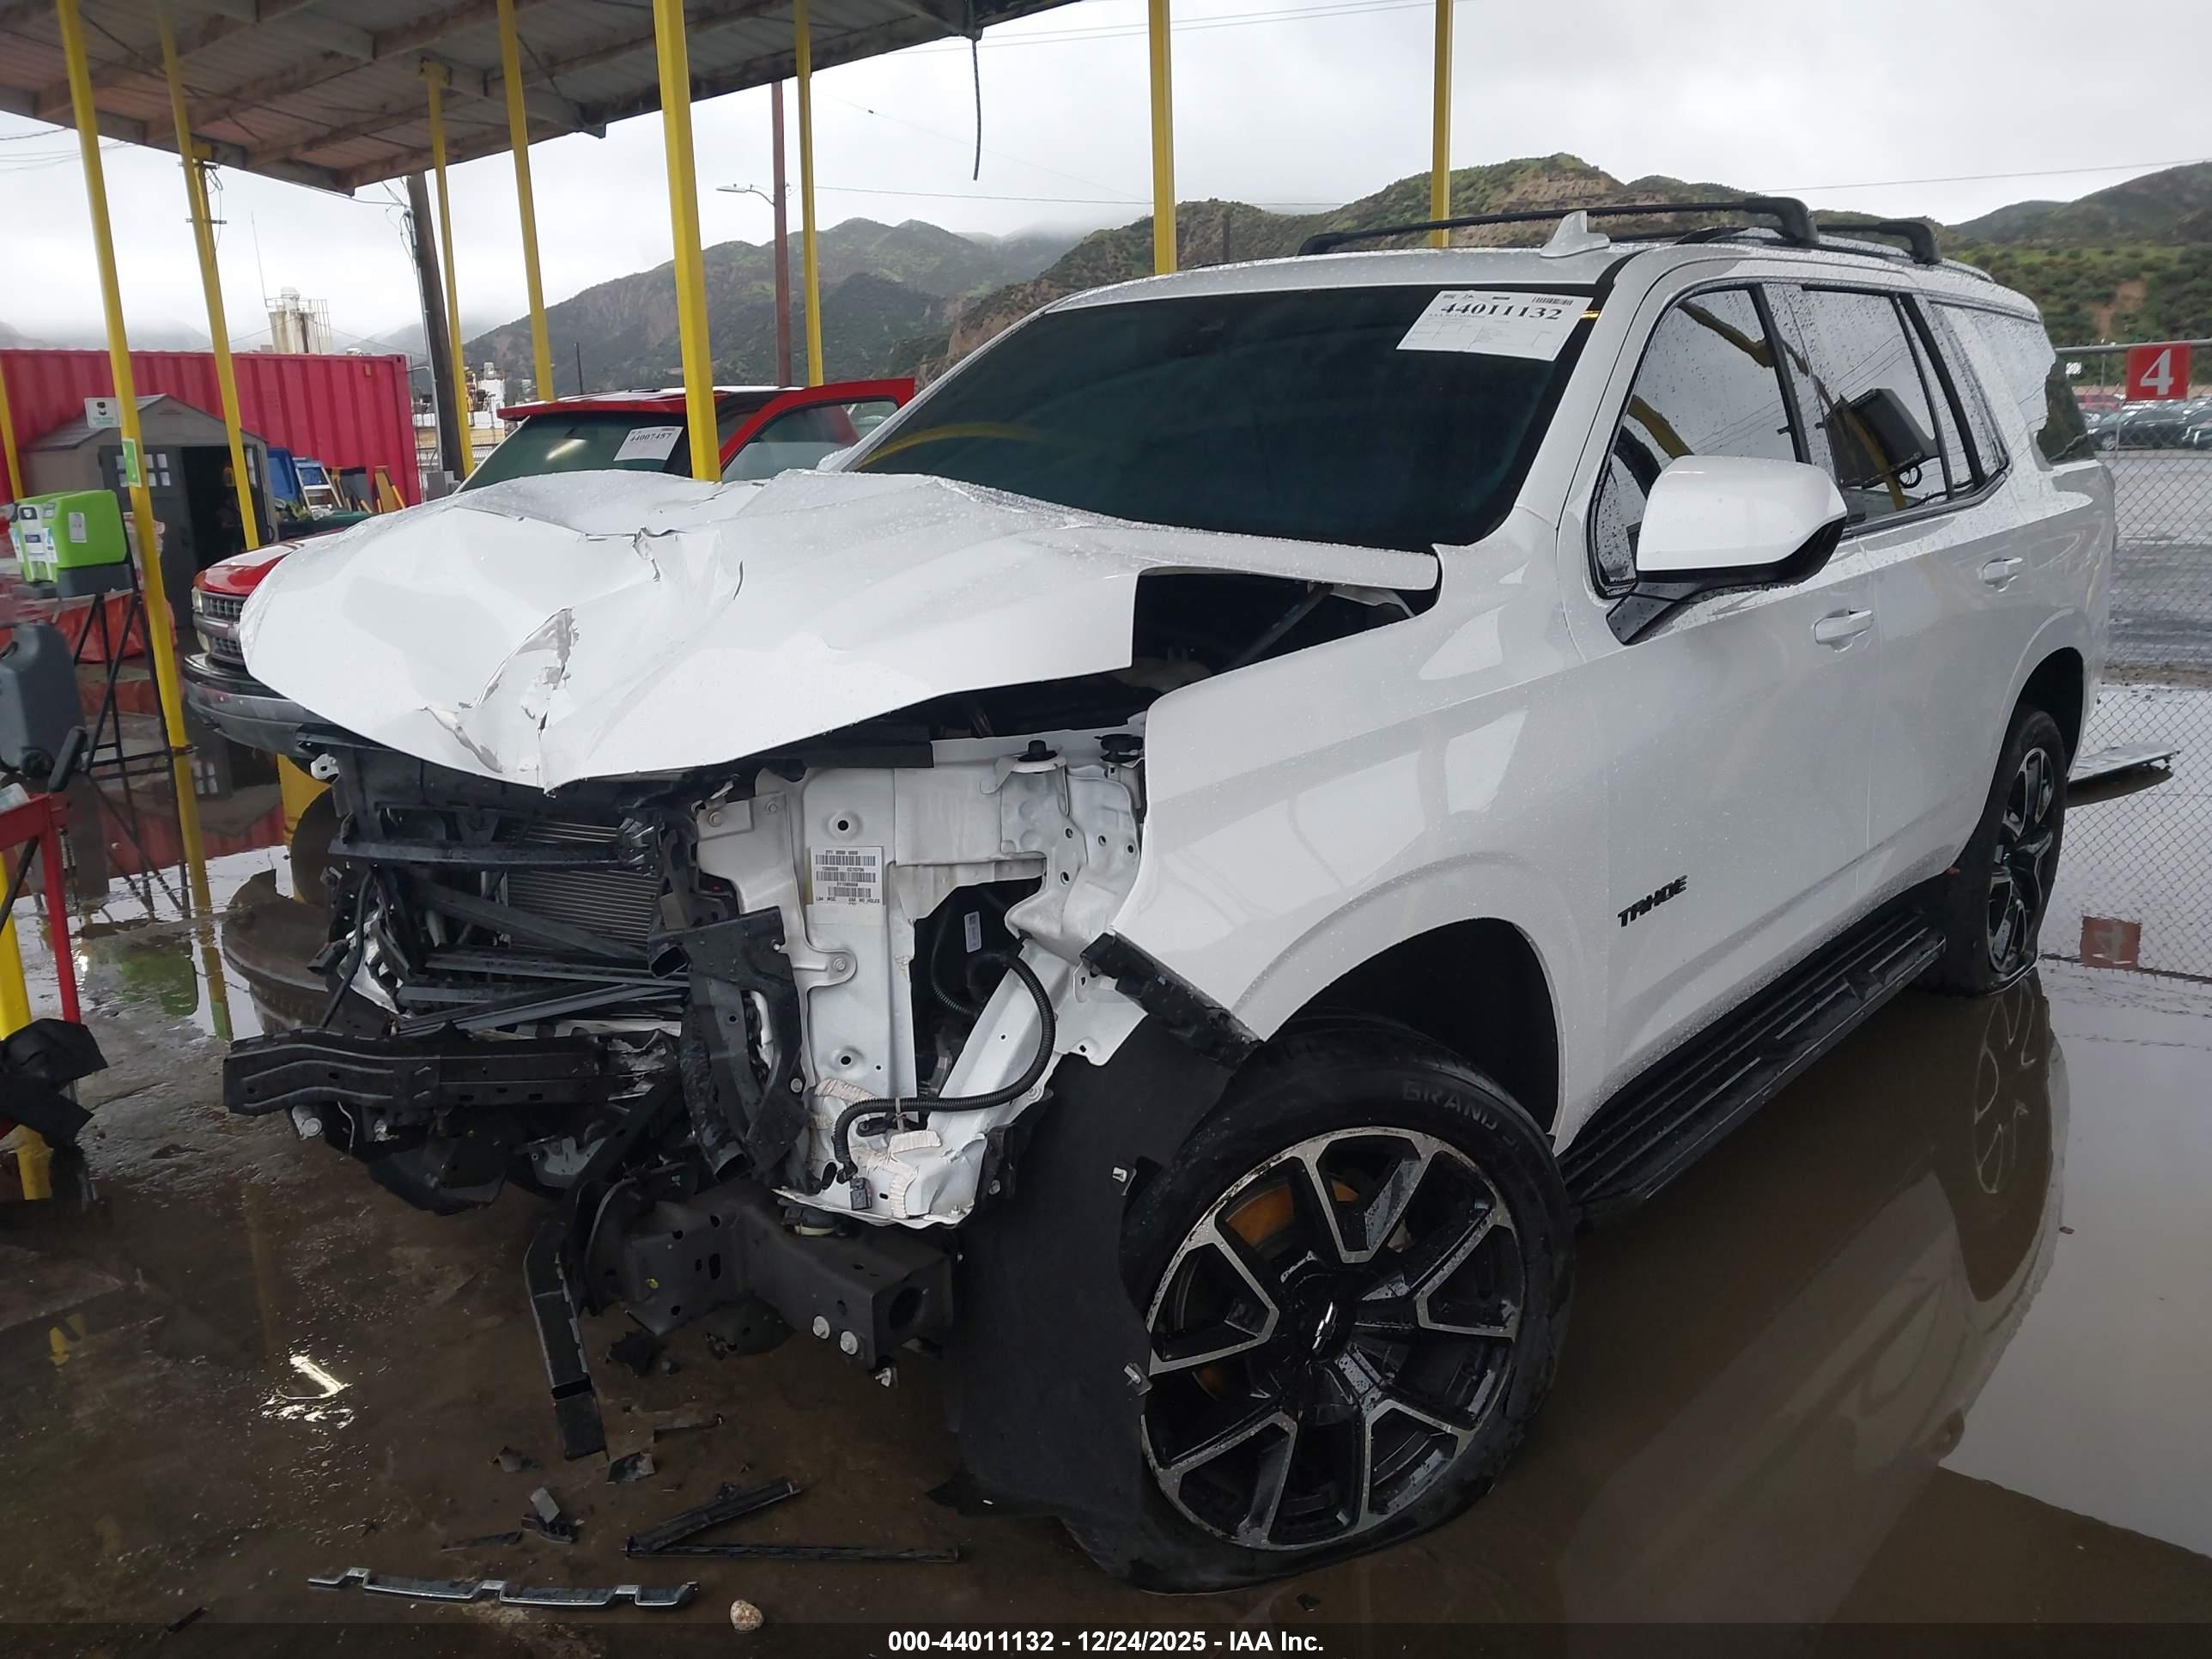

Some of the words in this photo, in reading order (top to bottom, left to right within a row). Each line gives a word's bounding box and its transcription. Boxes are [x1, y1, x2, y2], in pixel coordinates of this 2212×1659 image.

[1441, 302, 1563, 320] 44011132
[2139, 349, 2174, 396] 4
[1617, 874, 1688, 927] TAHOE
